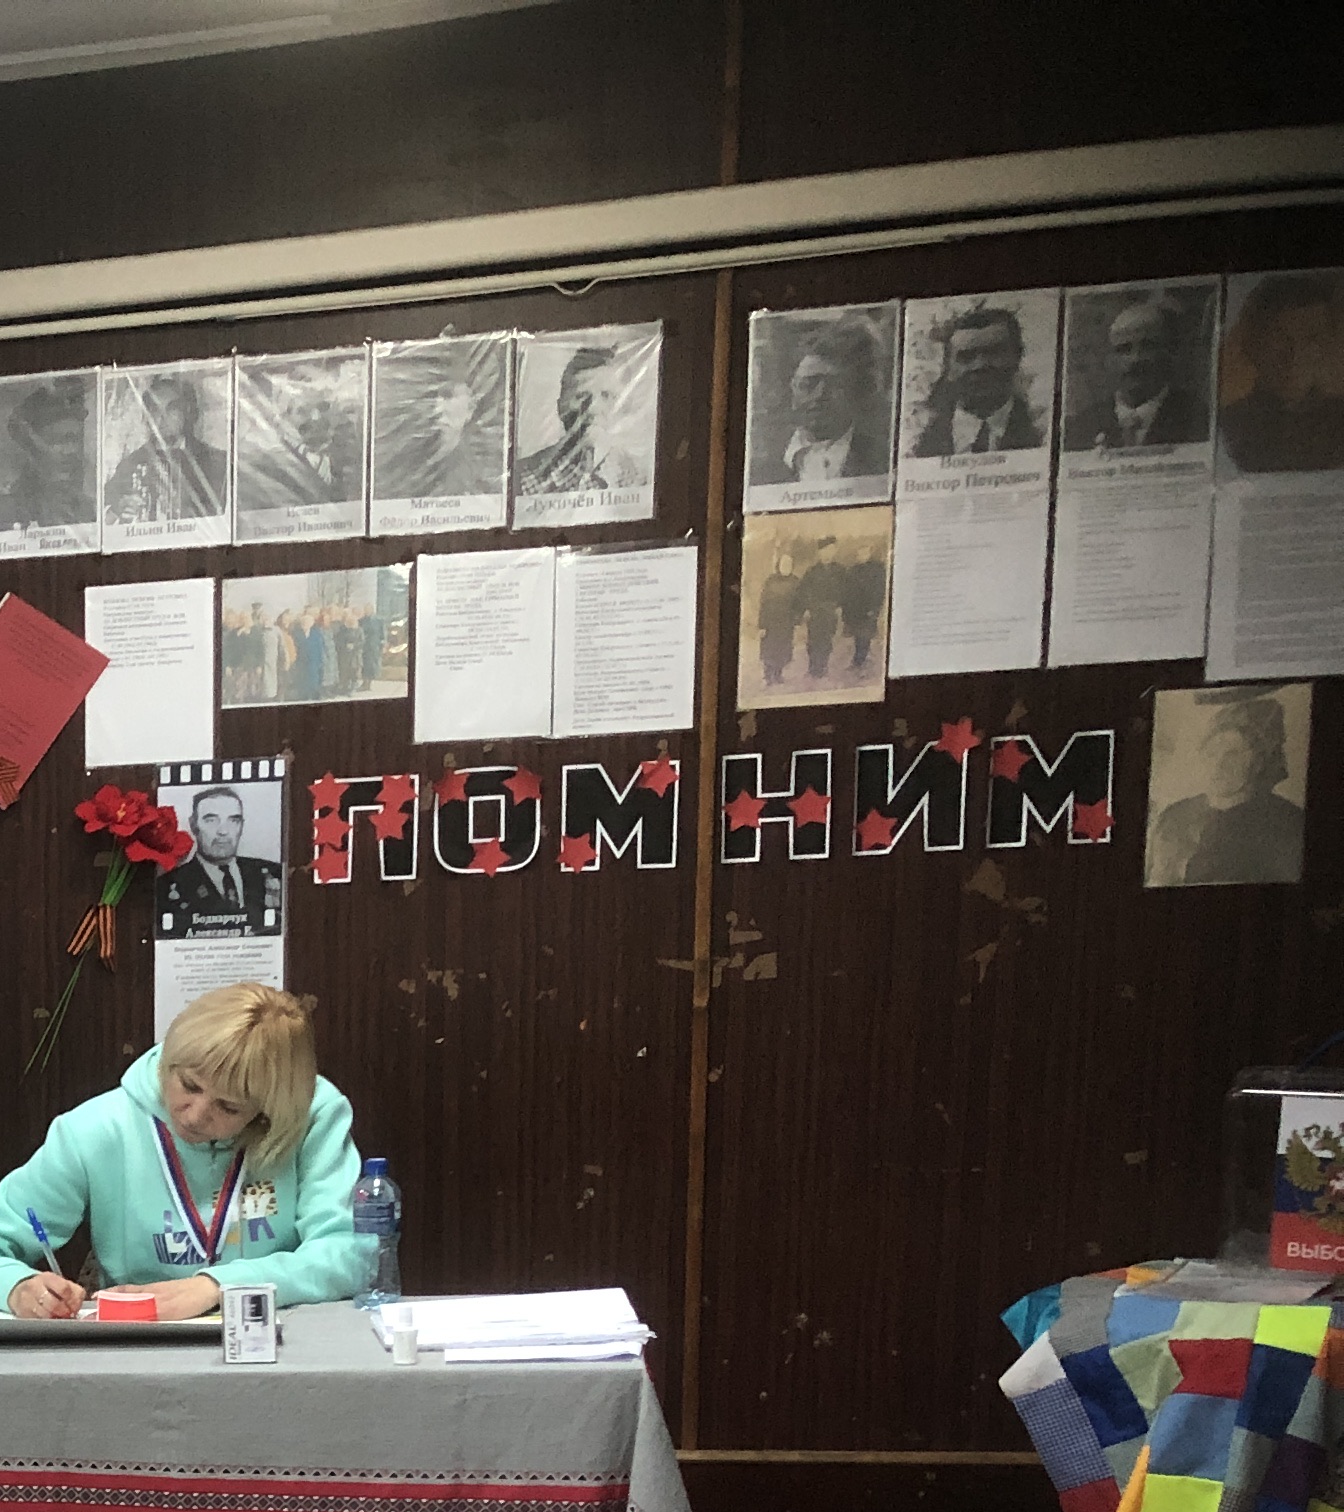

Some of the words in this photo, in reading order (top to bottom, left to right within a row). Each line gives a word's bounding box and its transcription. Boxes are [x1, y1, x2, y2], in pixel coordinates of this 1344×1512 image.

[904, 477, 961, 493] Виктор
[965, 471, 1041, 488] Петрович
[599, 491, 640, 507] Иван
[297, 519, 353, 534] Иванович
[420, 511, 491, 526] Васильевич
[310, 728, 1115, 885] ПОМНИМ
[1286, 1241, 1344, 1262] ВЫБО
[228, 1325, 238, 1360] IDEAL
